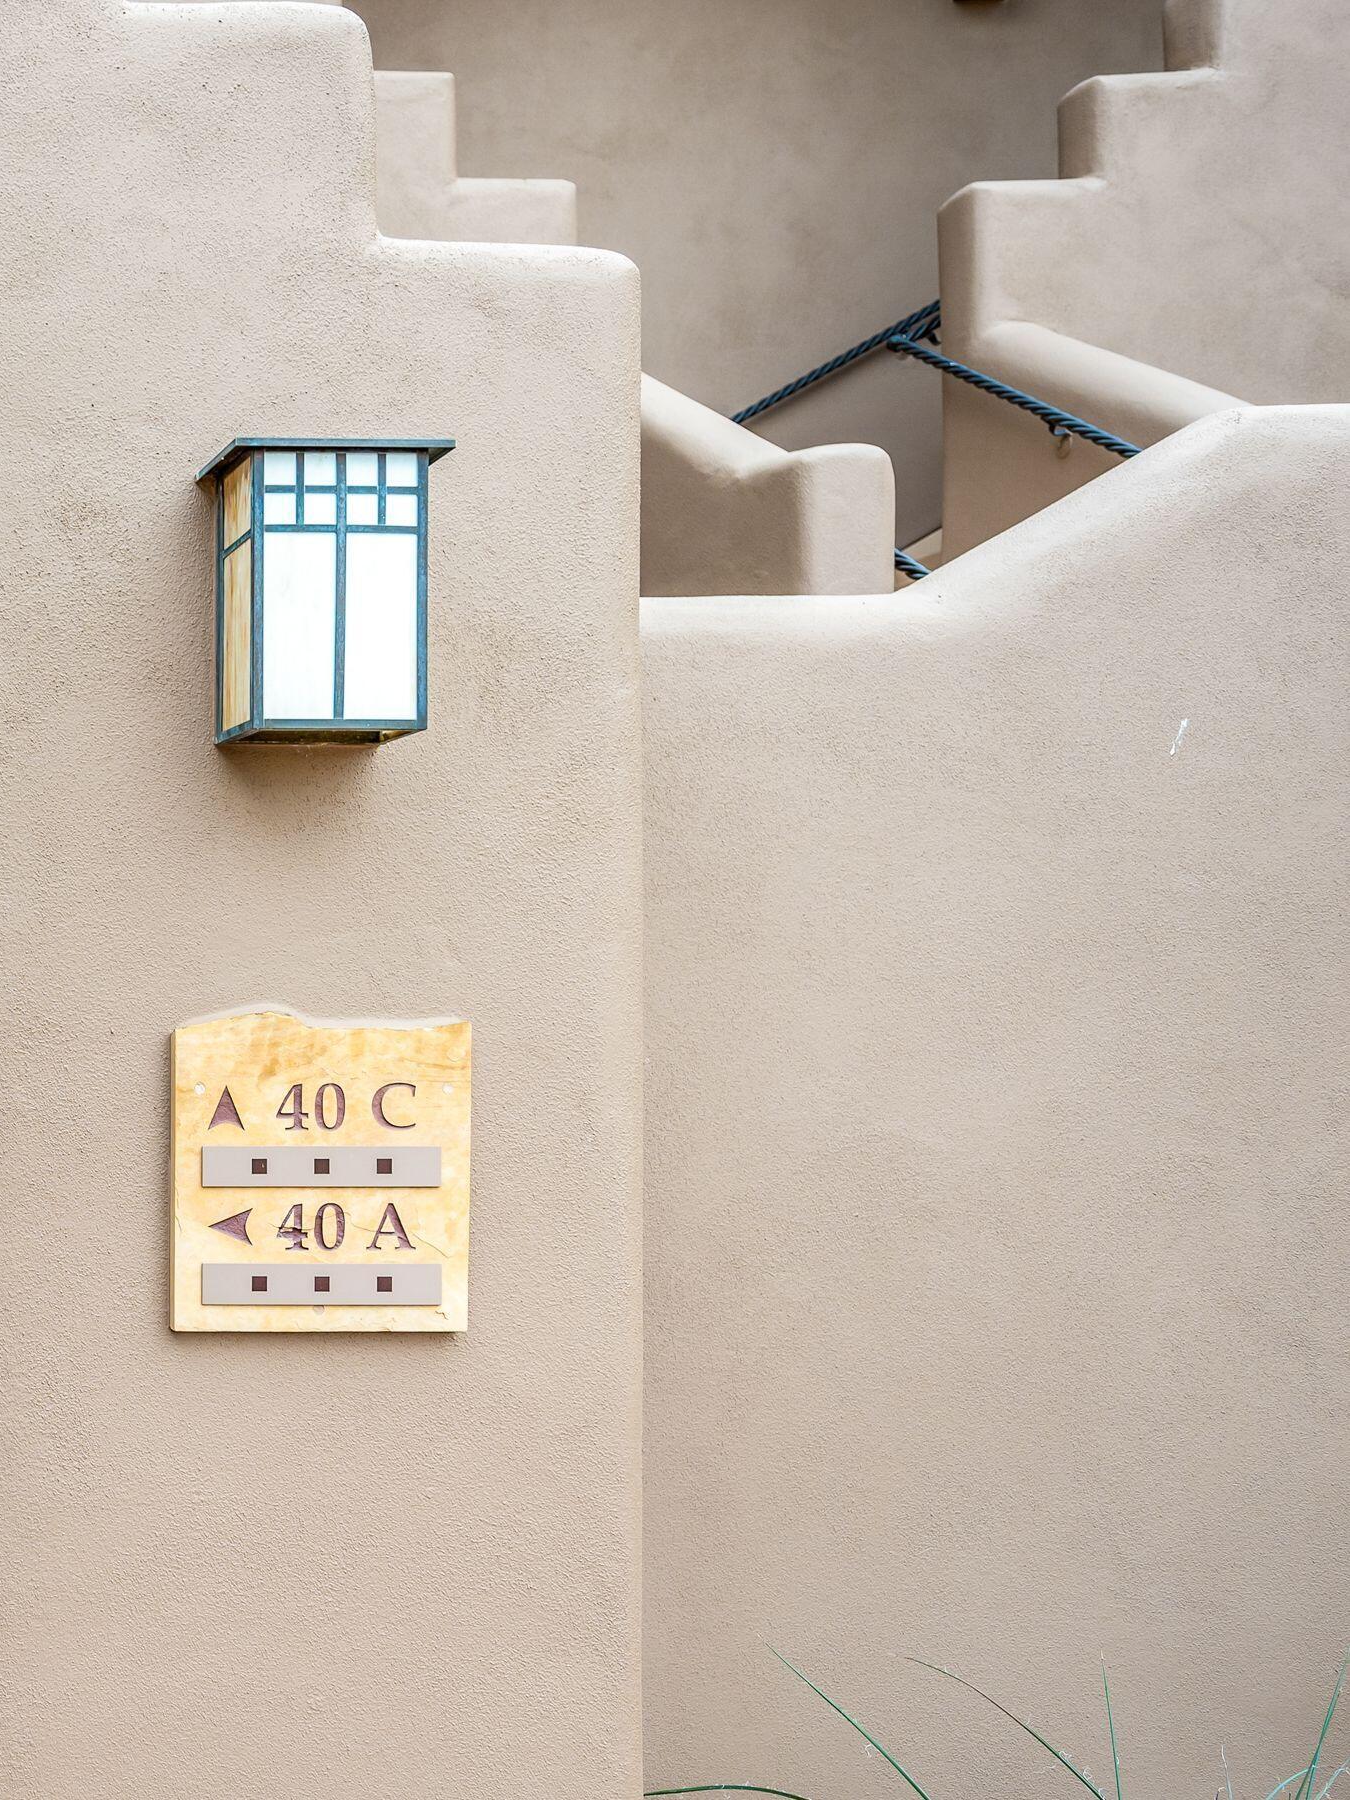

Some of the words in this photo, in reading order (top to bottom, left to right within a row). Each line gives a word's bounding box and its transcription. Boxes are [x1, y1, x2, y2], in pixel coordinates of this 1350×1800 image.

[276, 1082, 346, 1131] 40
[371, 1082, 417, 1131] C
[276, 1202, 346, 1251] 40
[366, 1202, 417, 1250] A
